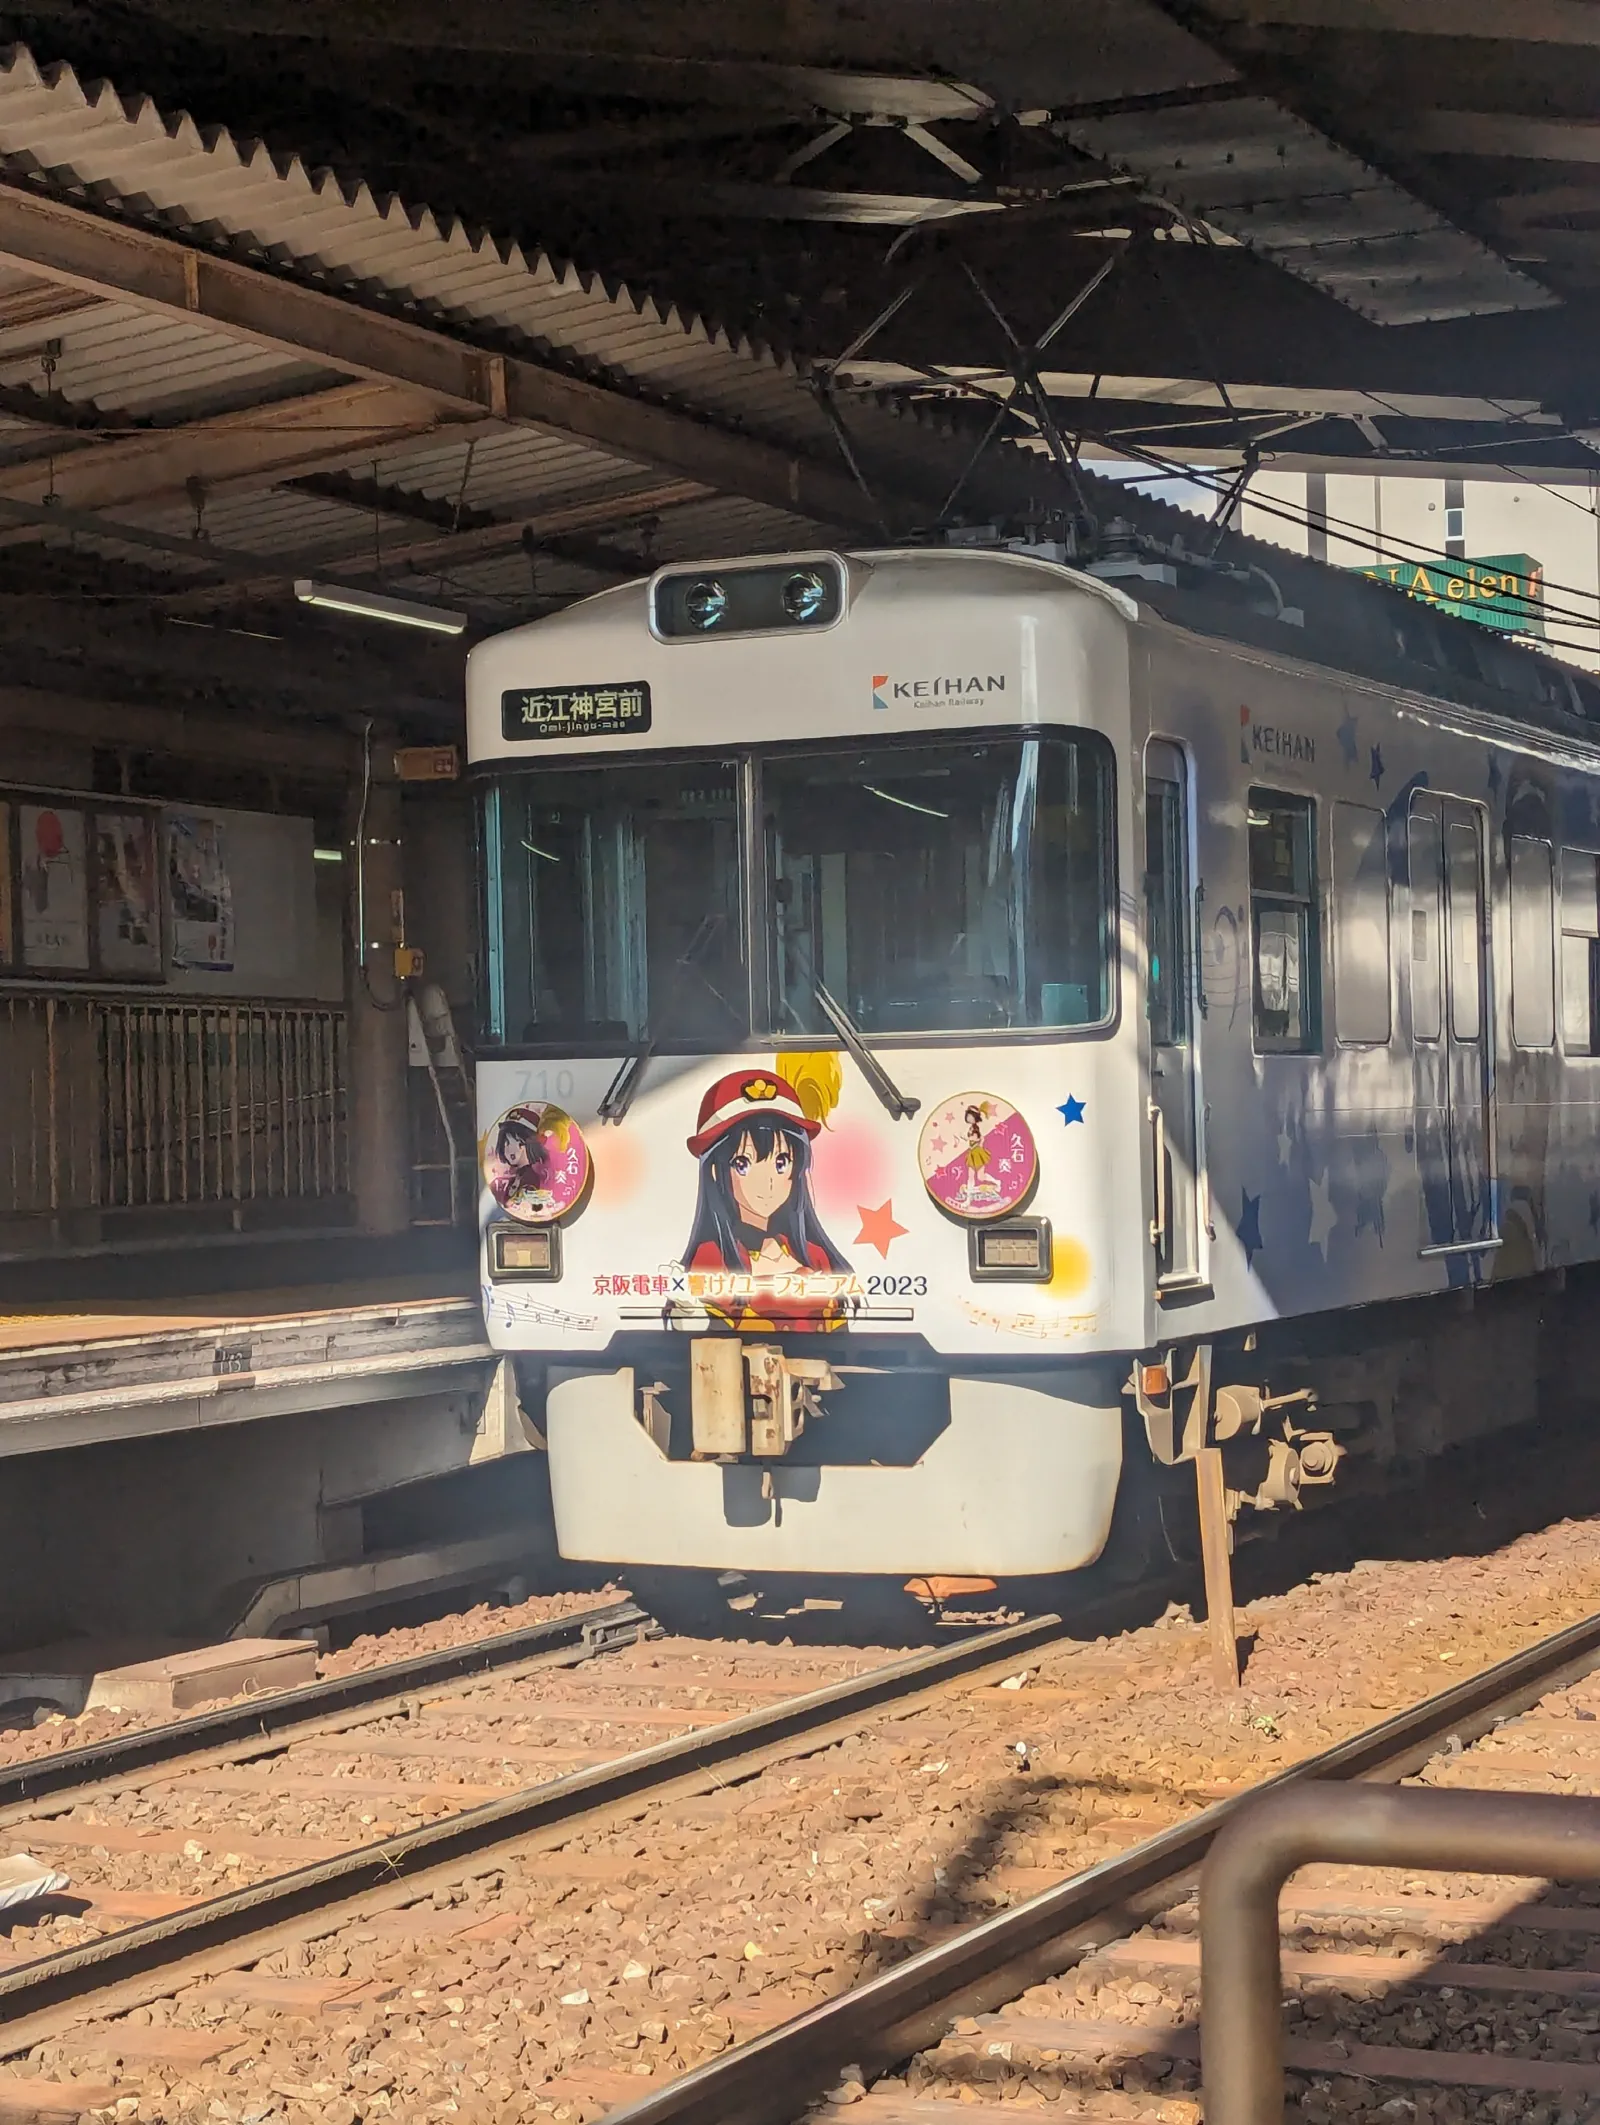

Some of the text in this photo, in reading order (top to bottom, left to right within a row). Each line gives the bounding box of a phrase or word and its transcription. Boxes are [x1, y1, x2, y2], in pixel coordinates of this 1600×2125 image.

[894, 675, 1005, 698] KEIHAN
[521, 688, 643, 723] 近江神宮前
[1252, 724, 1316, 763] KEIHAN
[515, 1069, 574, 1099] 710
[566, 1147, 579, 1175] 久石
[1010, 1133, 1024, 1162] 久石
